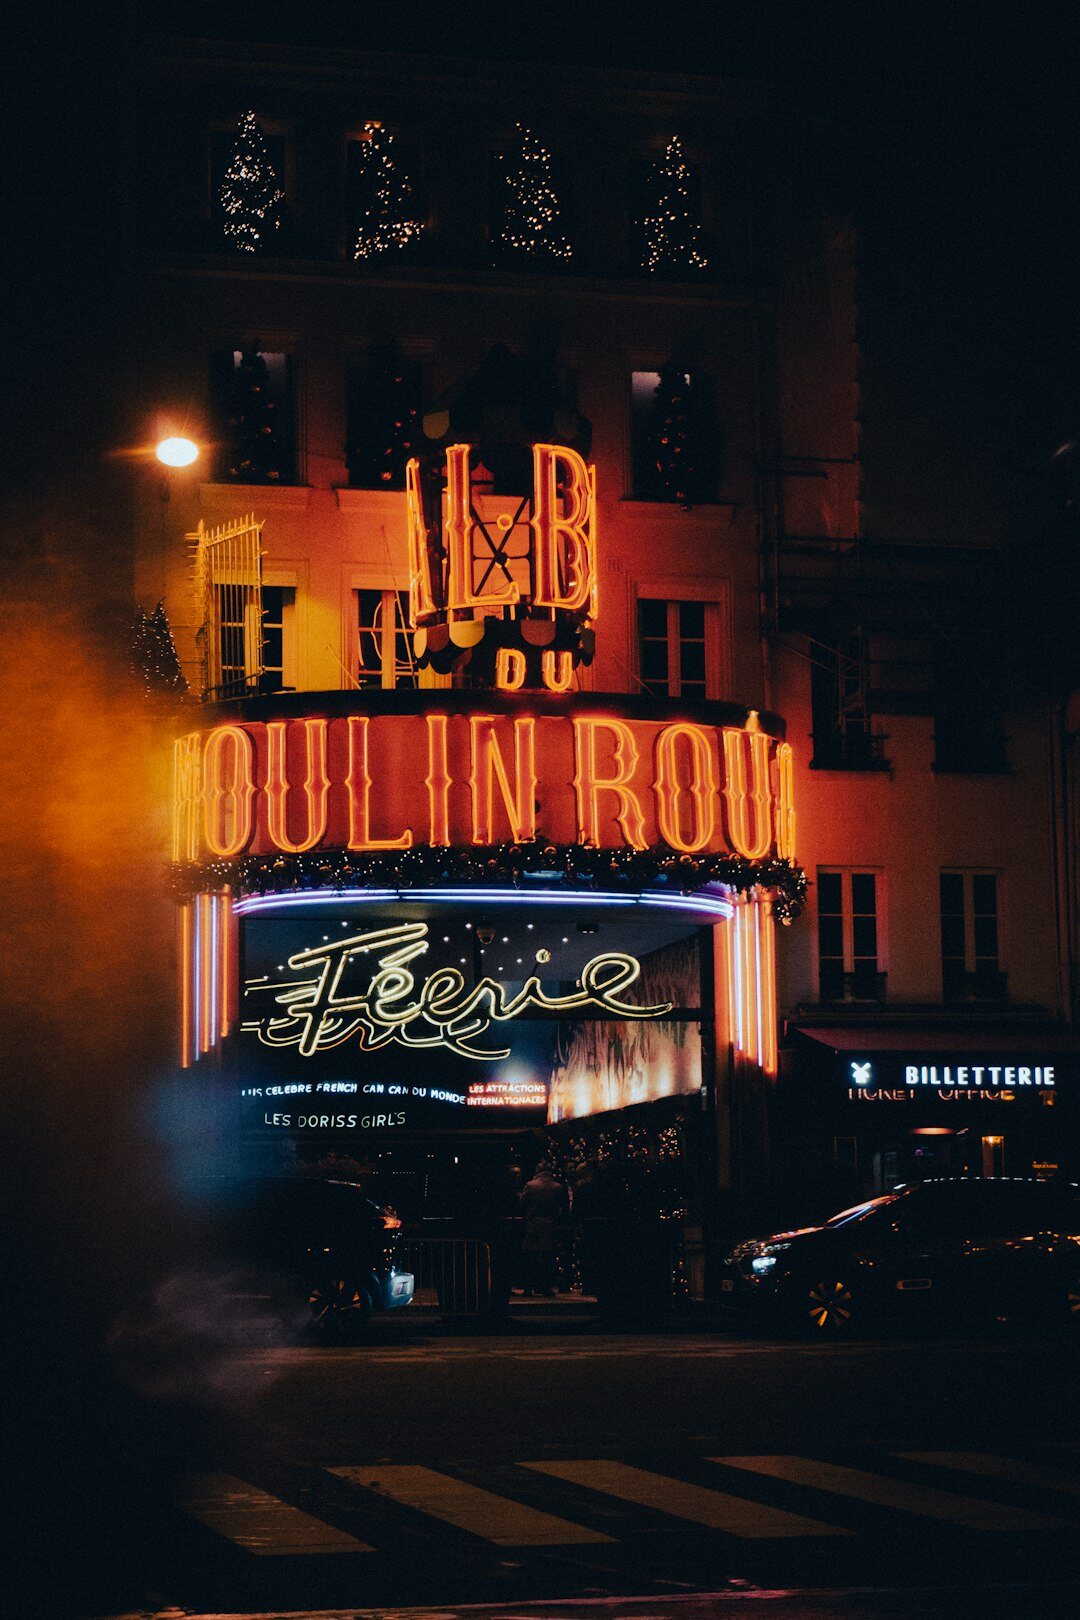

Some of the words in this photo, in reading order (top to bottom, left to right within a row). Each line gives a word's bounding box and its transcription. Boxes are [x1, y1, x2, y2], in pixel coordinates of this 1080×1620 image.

[497, 648, 573, 691] DU
[905, 1065, 1055, 1086] BILLETTERIE
[315, 1082, 358, 1094] FRENCH
[362, 1084, 385, 1094] CAN
[388, 1084, 409, 1095] CAN
[412, 1086, 427, 1097] DU
[430, 1089, 466, 1105] MONDE
[469, 1084, 484, 1094] LES
[485, 1084, 546, 1094] ATTRACTIONS
[264, 1112, 292, 1127] LES
[298, 1115, 357, 1128] DORISS
